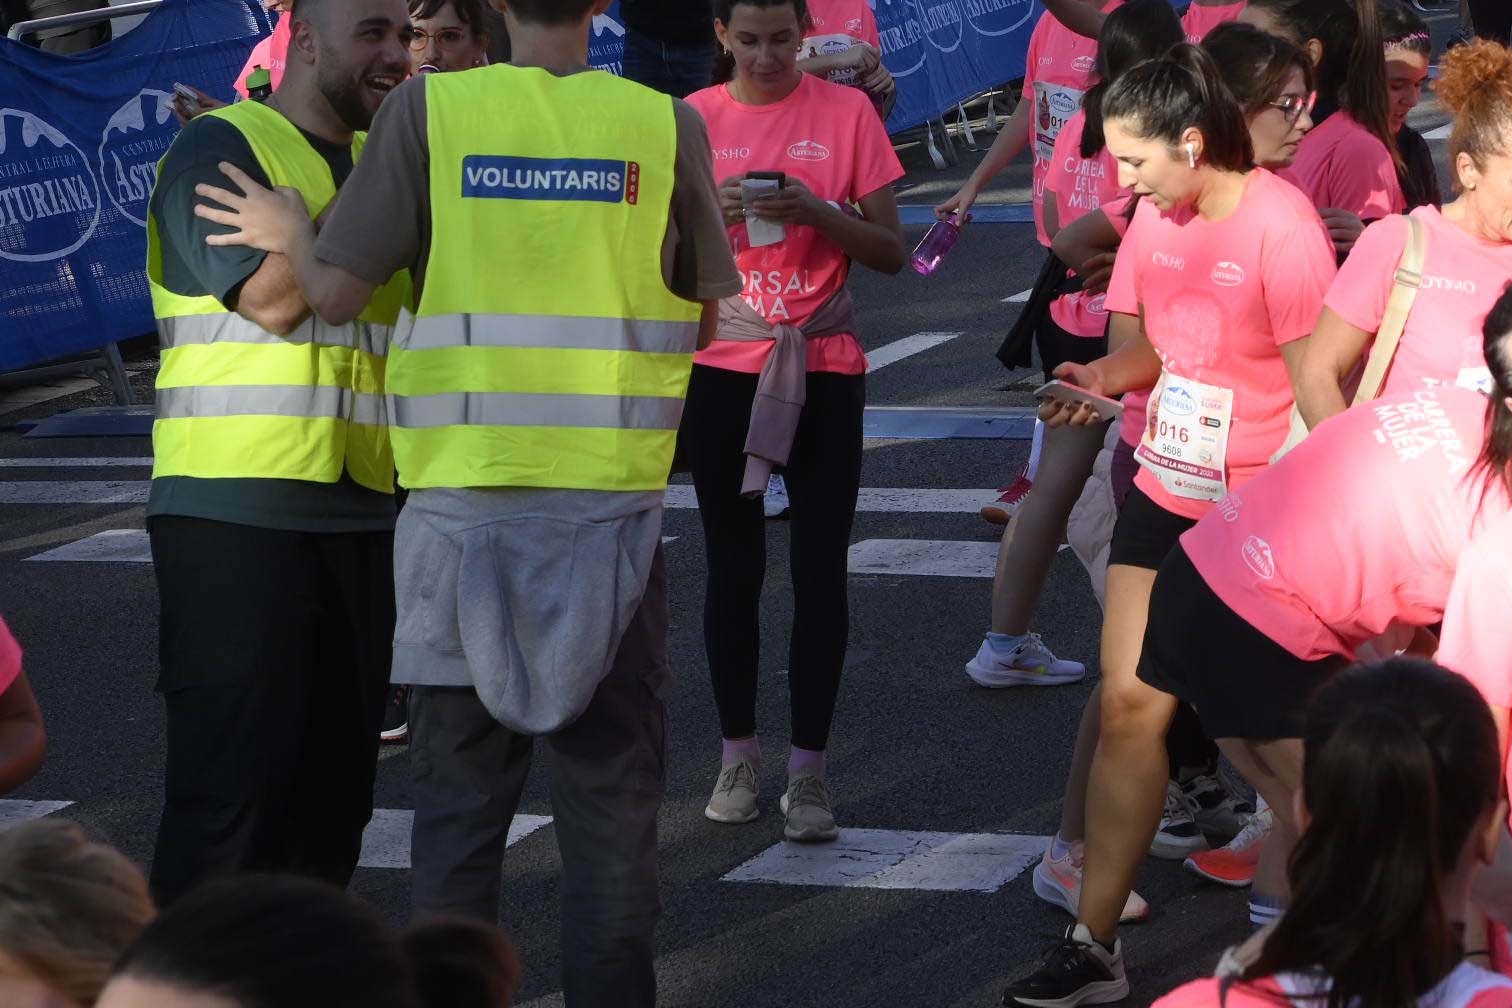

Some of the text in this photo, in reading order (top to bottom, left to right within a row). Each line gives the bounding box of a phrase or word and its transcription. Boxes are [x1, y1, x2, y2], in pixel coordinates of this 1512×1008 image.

[36, 153, 78, 171] LECHERA
[712, 148, 750, 160] YSHO
[466, 166, 621, 192] VOLUNTARIS
[1160, 420, 1189, 443] 016
[1162, 443, 1182, 457] 9608
[1168, 458, 1178, 468] LA
